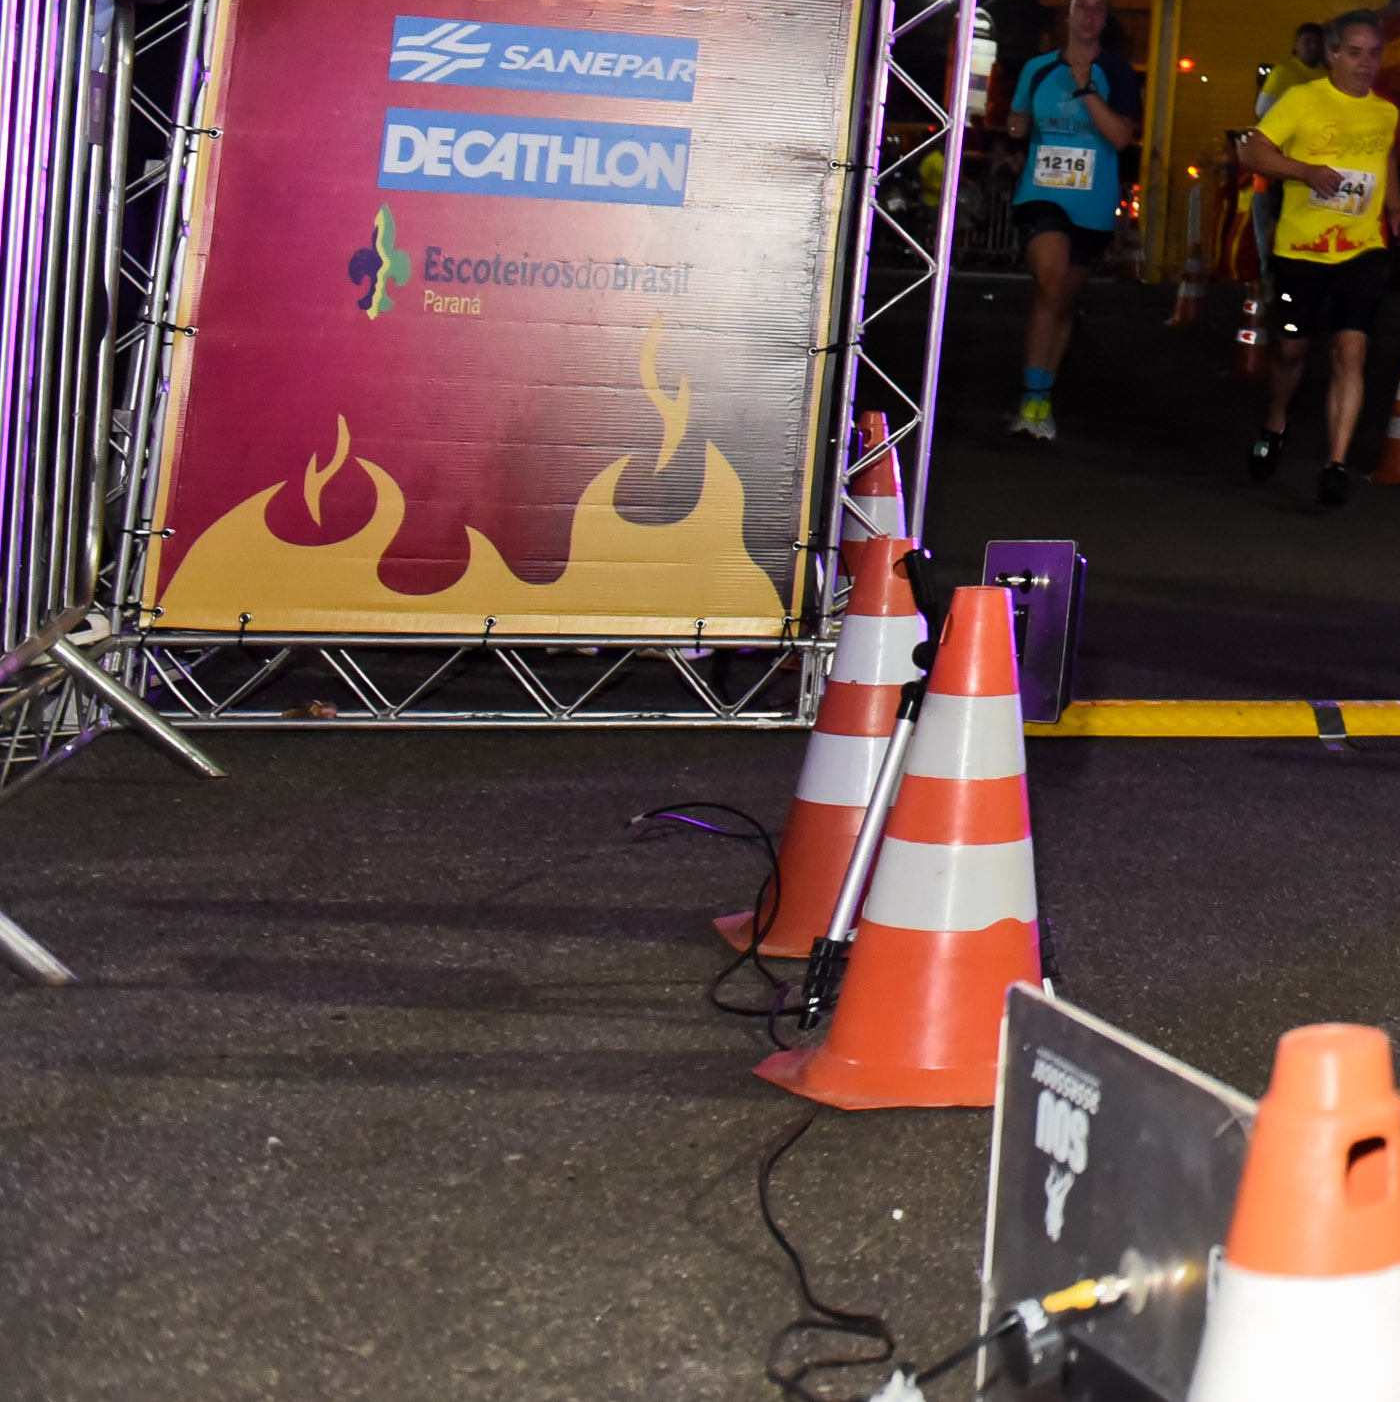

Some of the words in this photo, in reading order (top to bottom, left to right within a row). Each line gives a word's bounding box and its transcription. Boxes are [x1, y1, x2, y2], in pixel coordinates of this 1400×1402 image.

[498, 45, 697, 83] SANEPAR
[382, 123, 687, 191] DECATHLON
[1042, 156, 1086, 171] 1216
[422, 290, 481, 316] Paraná
